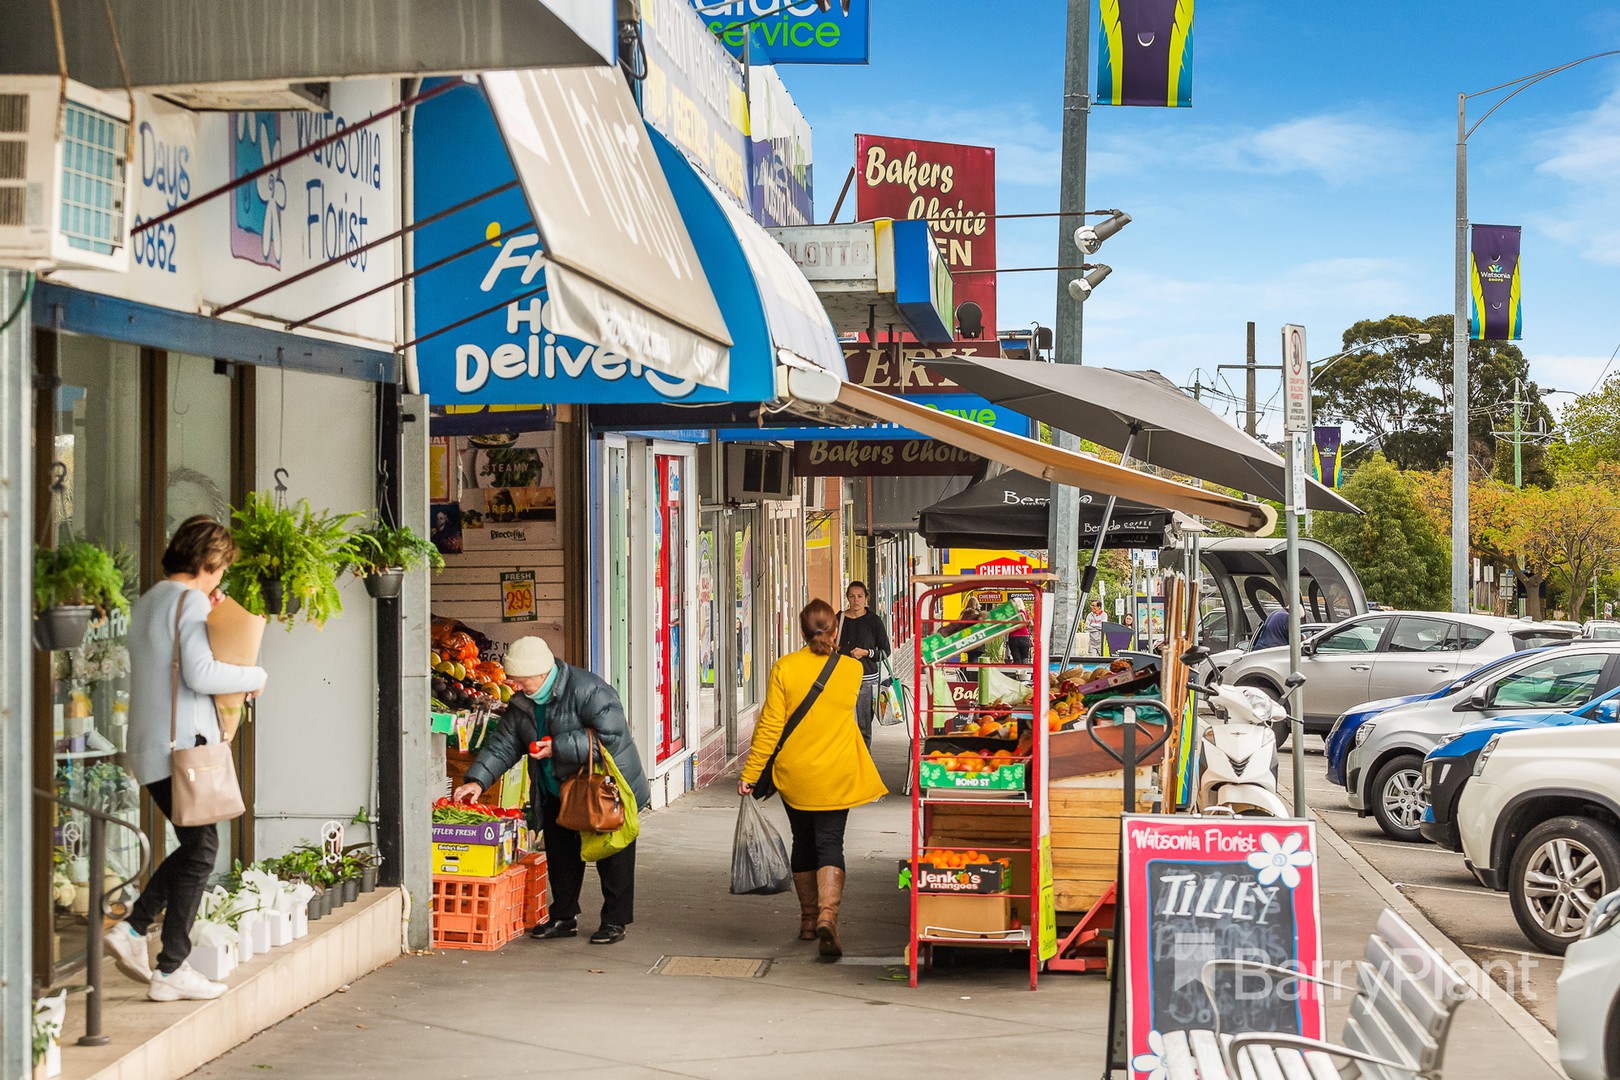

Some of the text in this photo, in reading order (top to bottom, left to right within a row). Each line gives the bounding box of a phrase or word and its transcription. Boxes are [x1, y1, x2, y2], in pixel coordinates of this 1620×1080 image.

[139, 121, 191, 210] Days
[865, 146, 954, 194] Bakers
[306, 178, 368, 273] Florist
[907, 195, 987, 236] Choice
[810, 440, 895, 468] Bakers
[482, 463, 530, 473] STEAMY
[505, 572, 532, 580] FRESH
[979, 565, 1030, 576] CHEMIST
[955, 777, 990, 786] BOND ST
[1131, 828, 1257, 853] Watsonia Florist
[930, 882, 979, 891] mangoes
